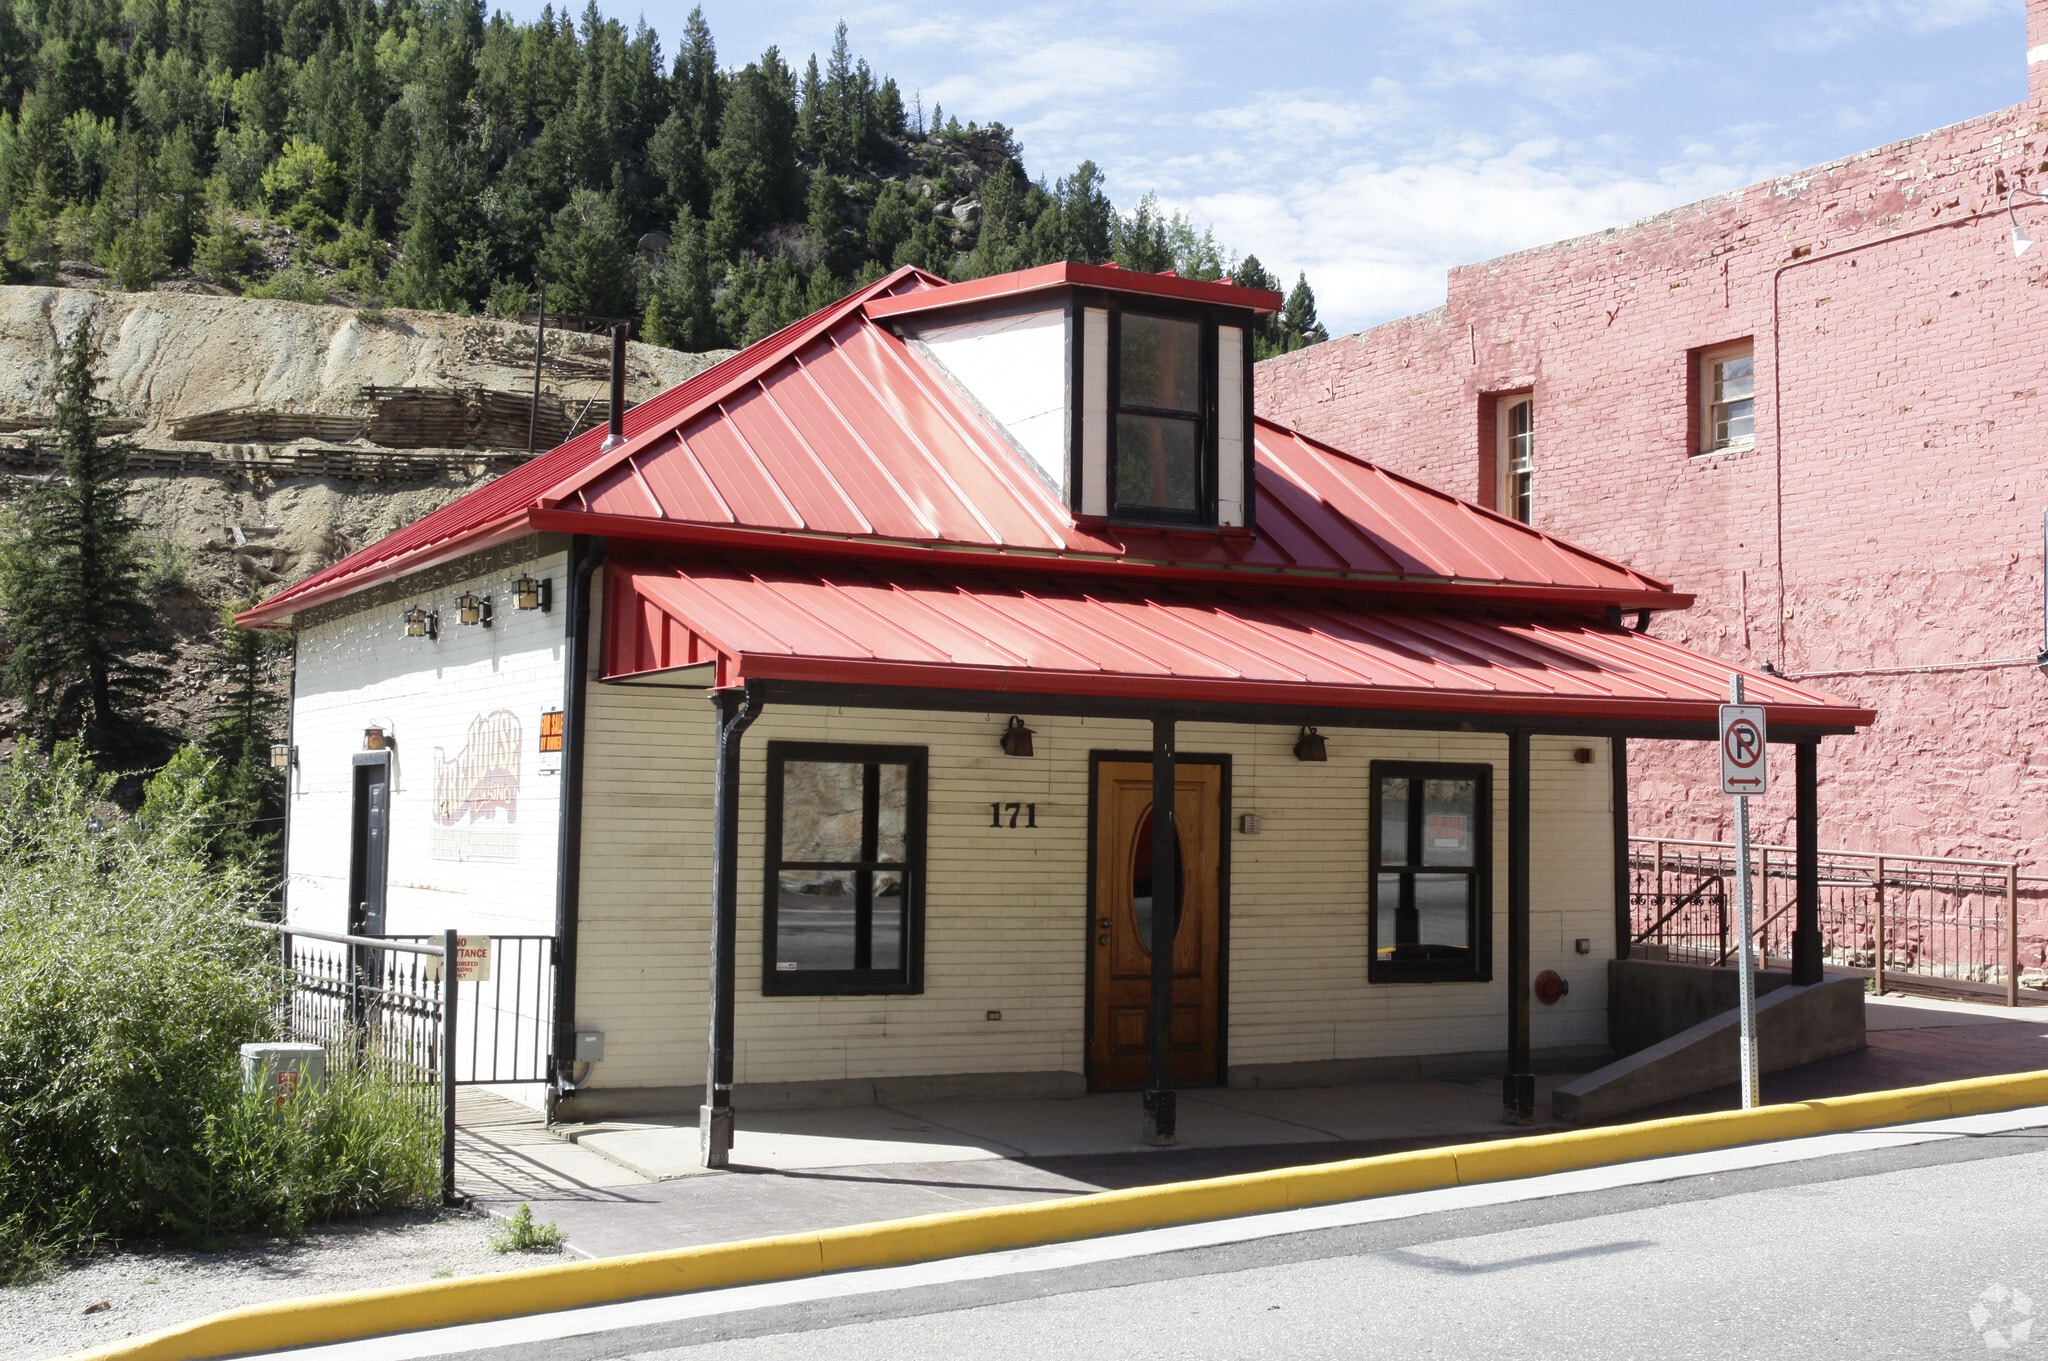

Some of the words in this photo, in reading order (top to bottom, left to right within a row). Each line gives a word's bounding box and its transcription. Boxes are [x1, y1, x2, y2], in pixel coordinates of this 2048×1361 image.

[547, 736, 562, 750] OWNE
[433, 711, 519, 817] FIREHOUSE
[473, 784, 511, 813] CASINO
[990, 802, 1038, 828] 171
